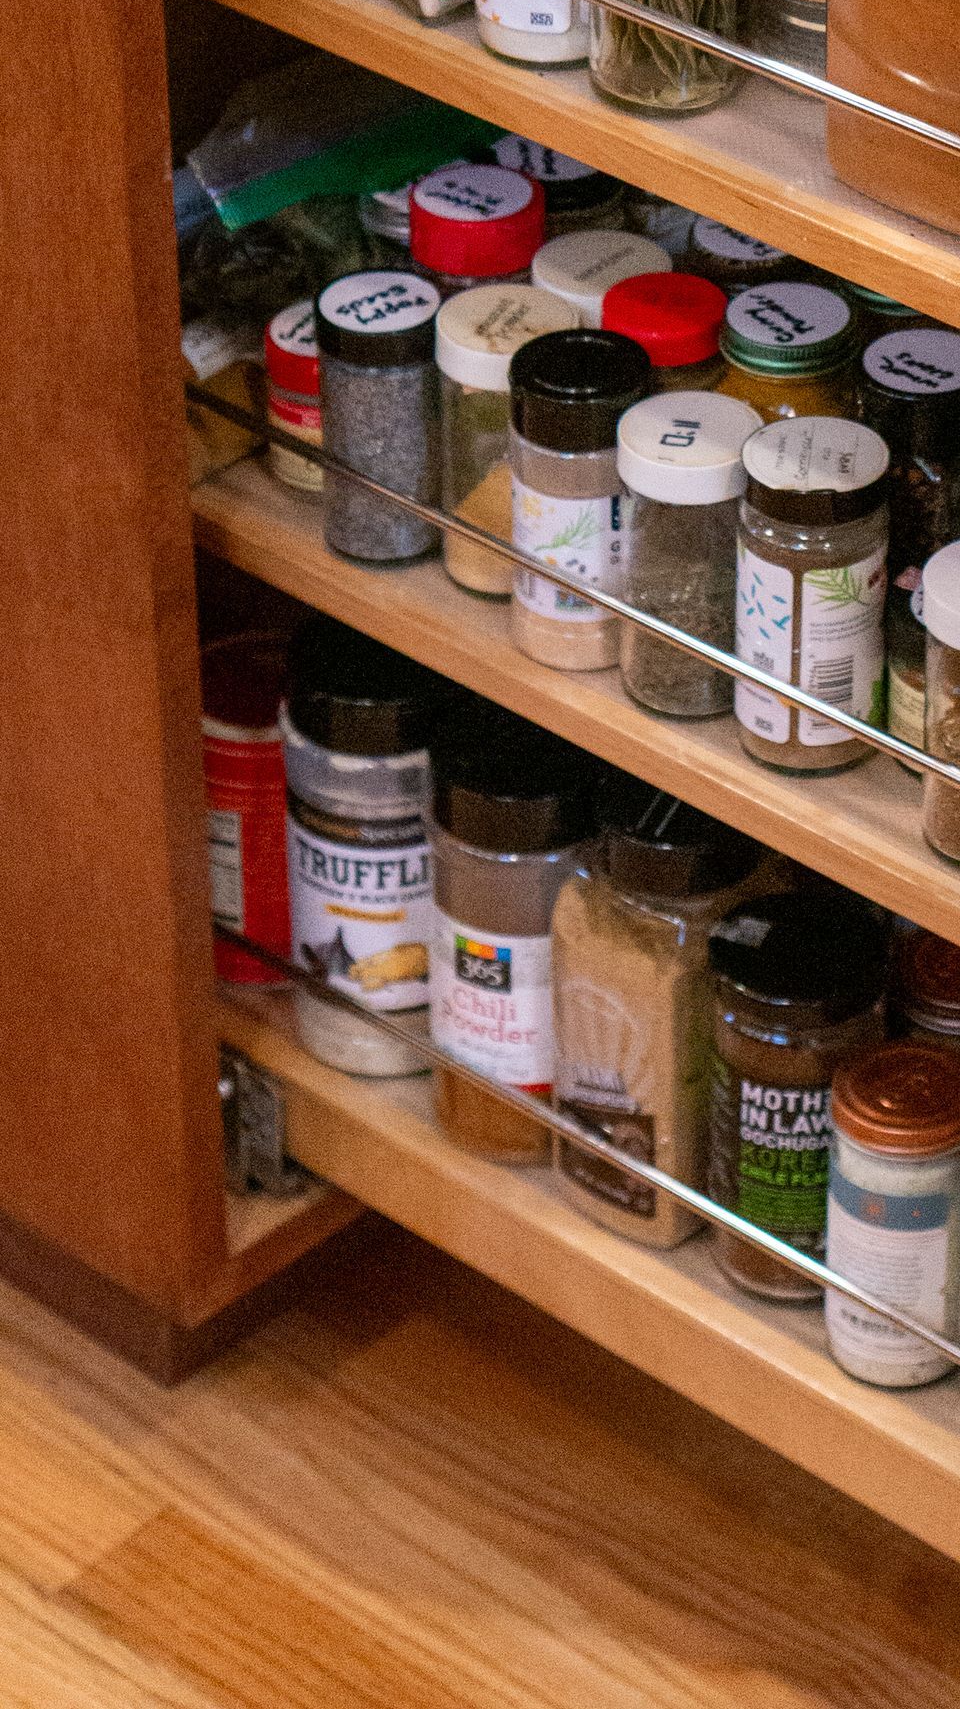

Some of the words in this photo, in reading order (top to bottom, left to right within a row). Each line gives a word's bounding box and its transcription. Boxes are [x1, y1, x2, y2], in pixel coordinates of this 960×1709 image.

[744, 307, 795, 343] Curry
[459, 955, 505, 986] 365
[453, 986, 517, 1022] Chili
[741, 1080, 829, 1113] MOTH
[741, 1103, 768, 1131] IN
